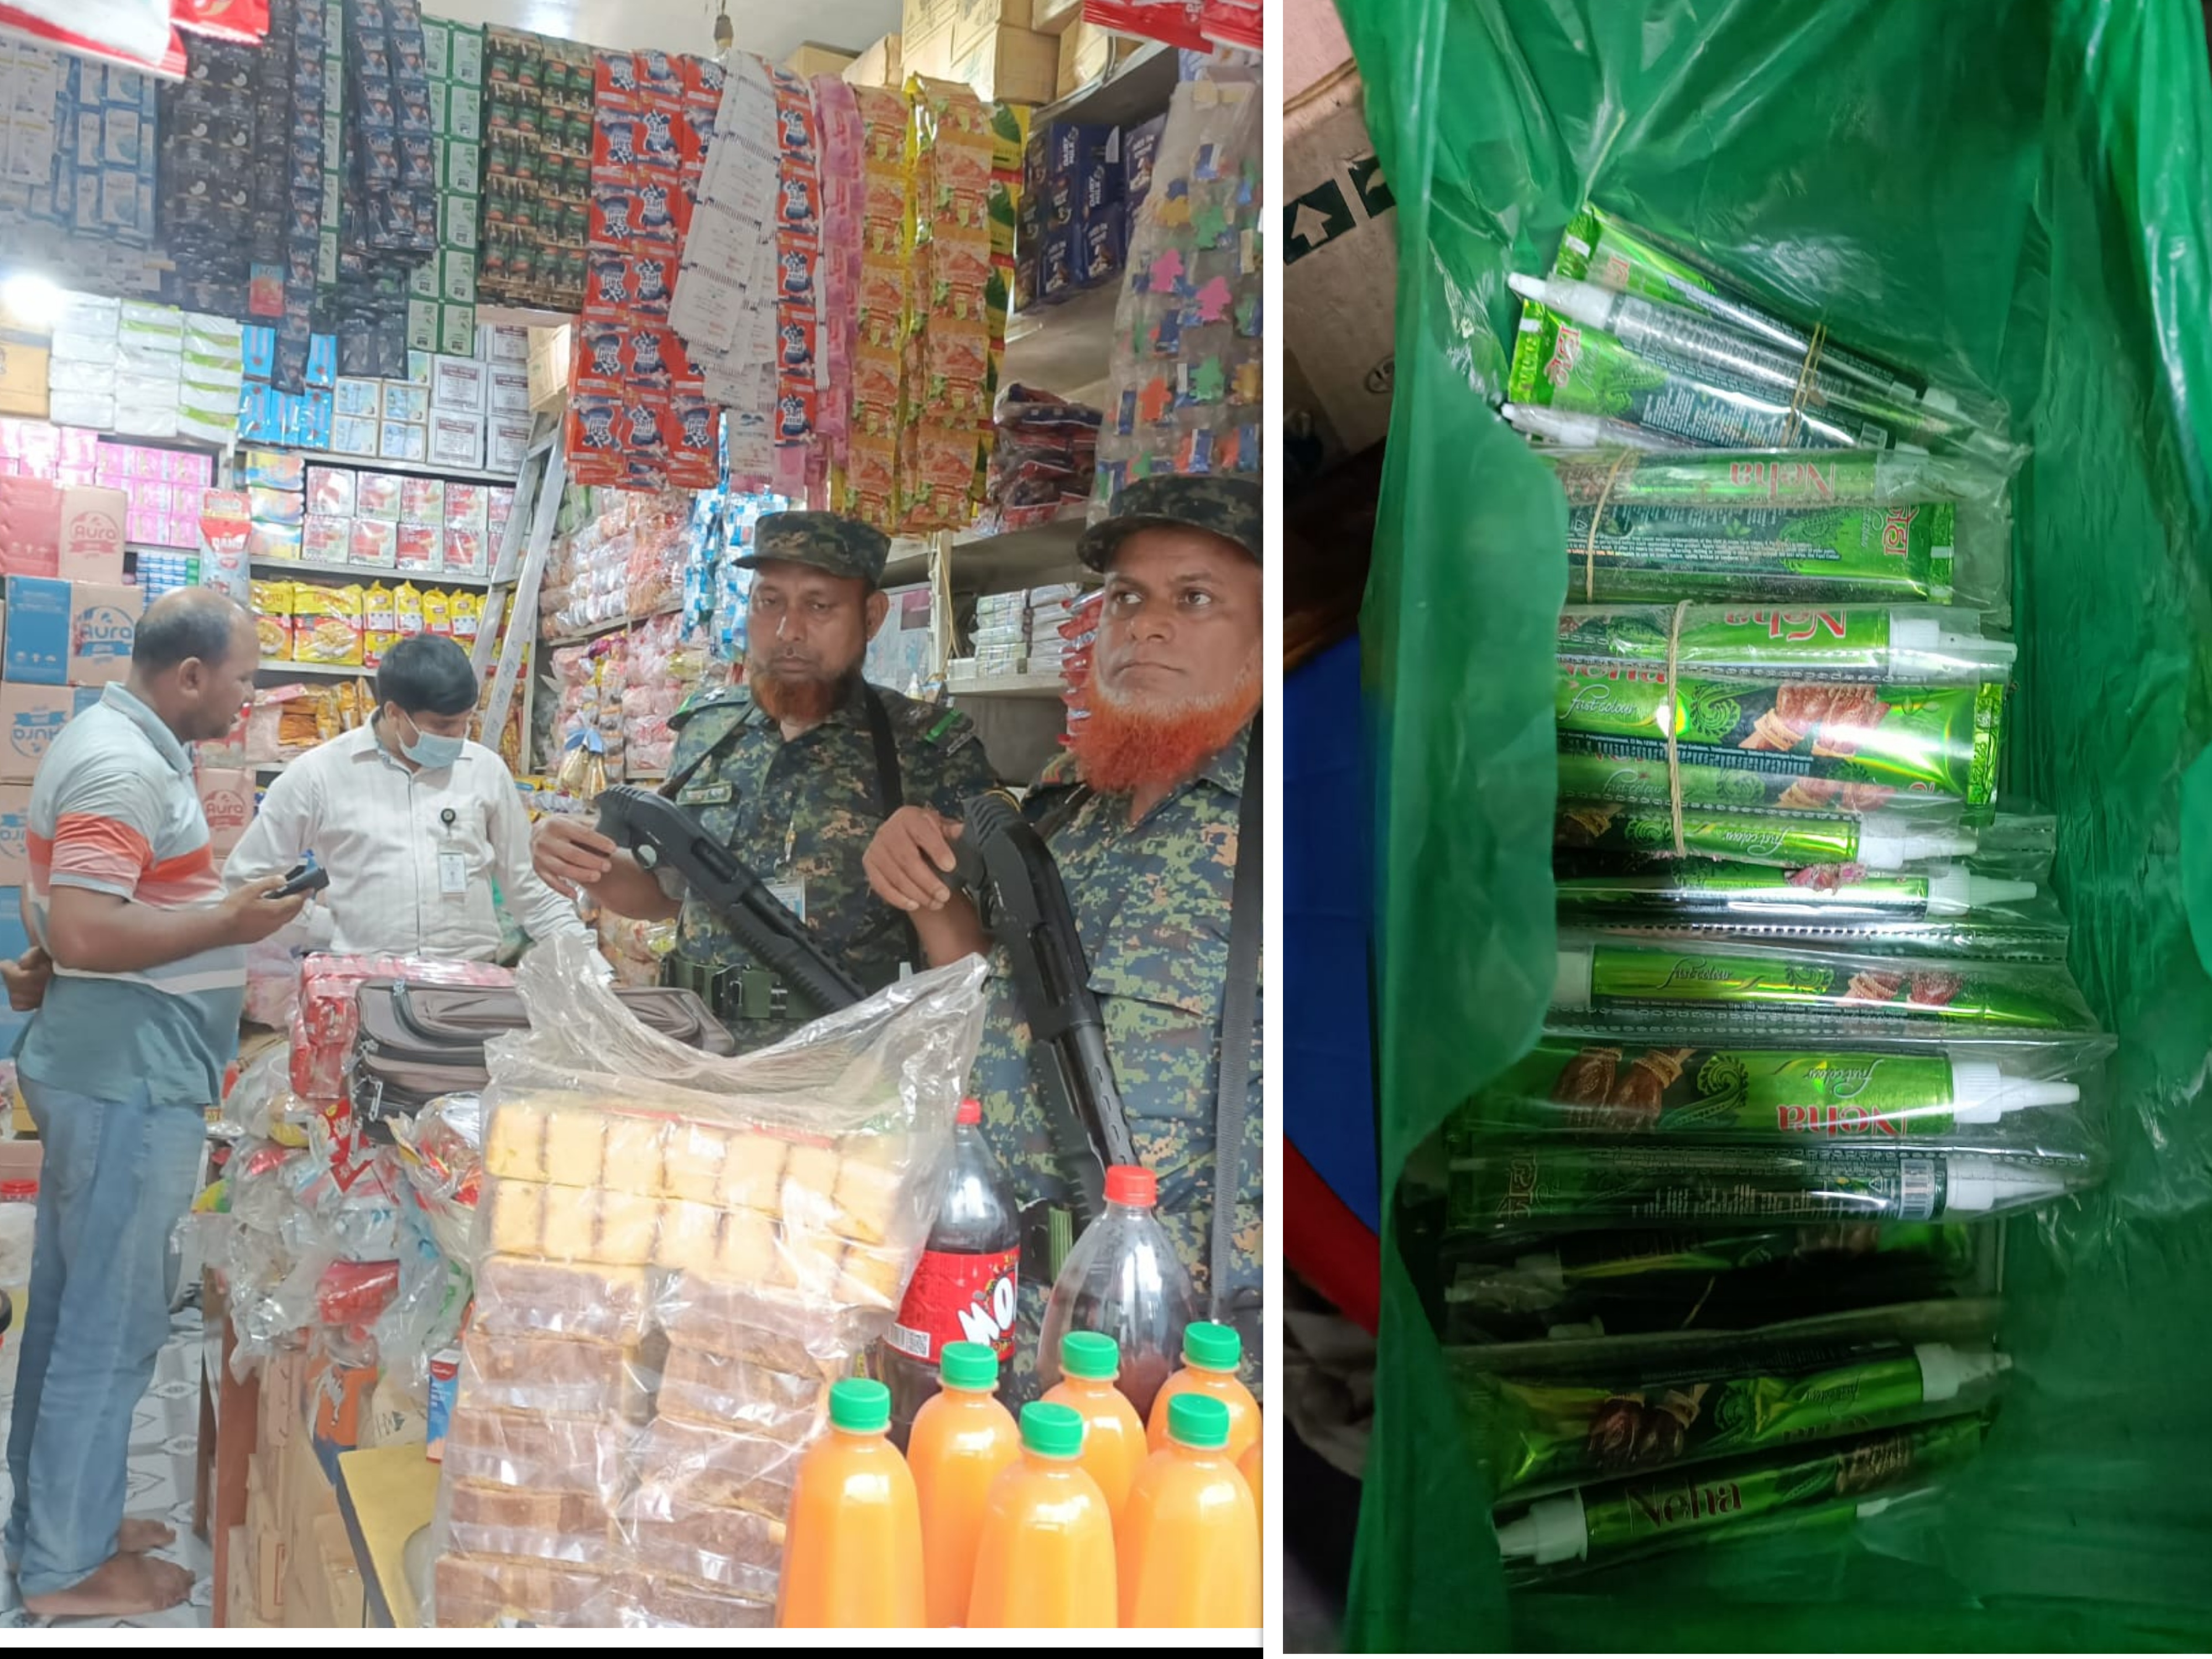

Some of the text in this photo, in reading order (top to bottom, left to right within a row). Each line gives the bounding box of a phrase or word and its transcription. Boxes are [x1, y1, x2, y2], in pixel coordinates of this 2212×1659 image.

[1730, 461, 1835, 501] Neha
[74, 524, 117, 540] Aura
[80, 624, 133, 639] Aura
[1598, 698, 1637, 714] colour
[206, 803, 244, 814] Aura
[1804, 1068, 1844, 1086] colour
[1777, 1105, 1907, 1137] Neha
[957, 1261, 1019, 1346] MO
[1626, 1481, 1742, 1533] Neha
